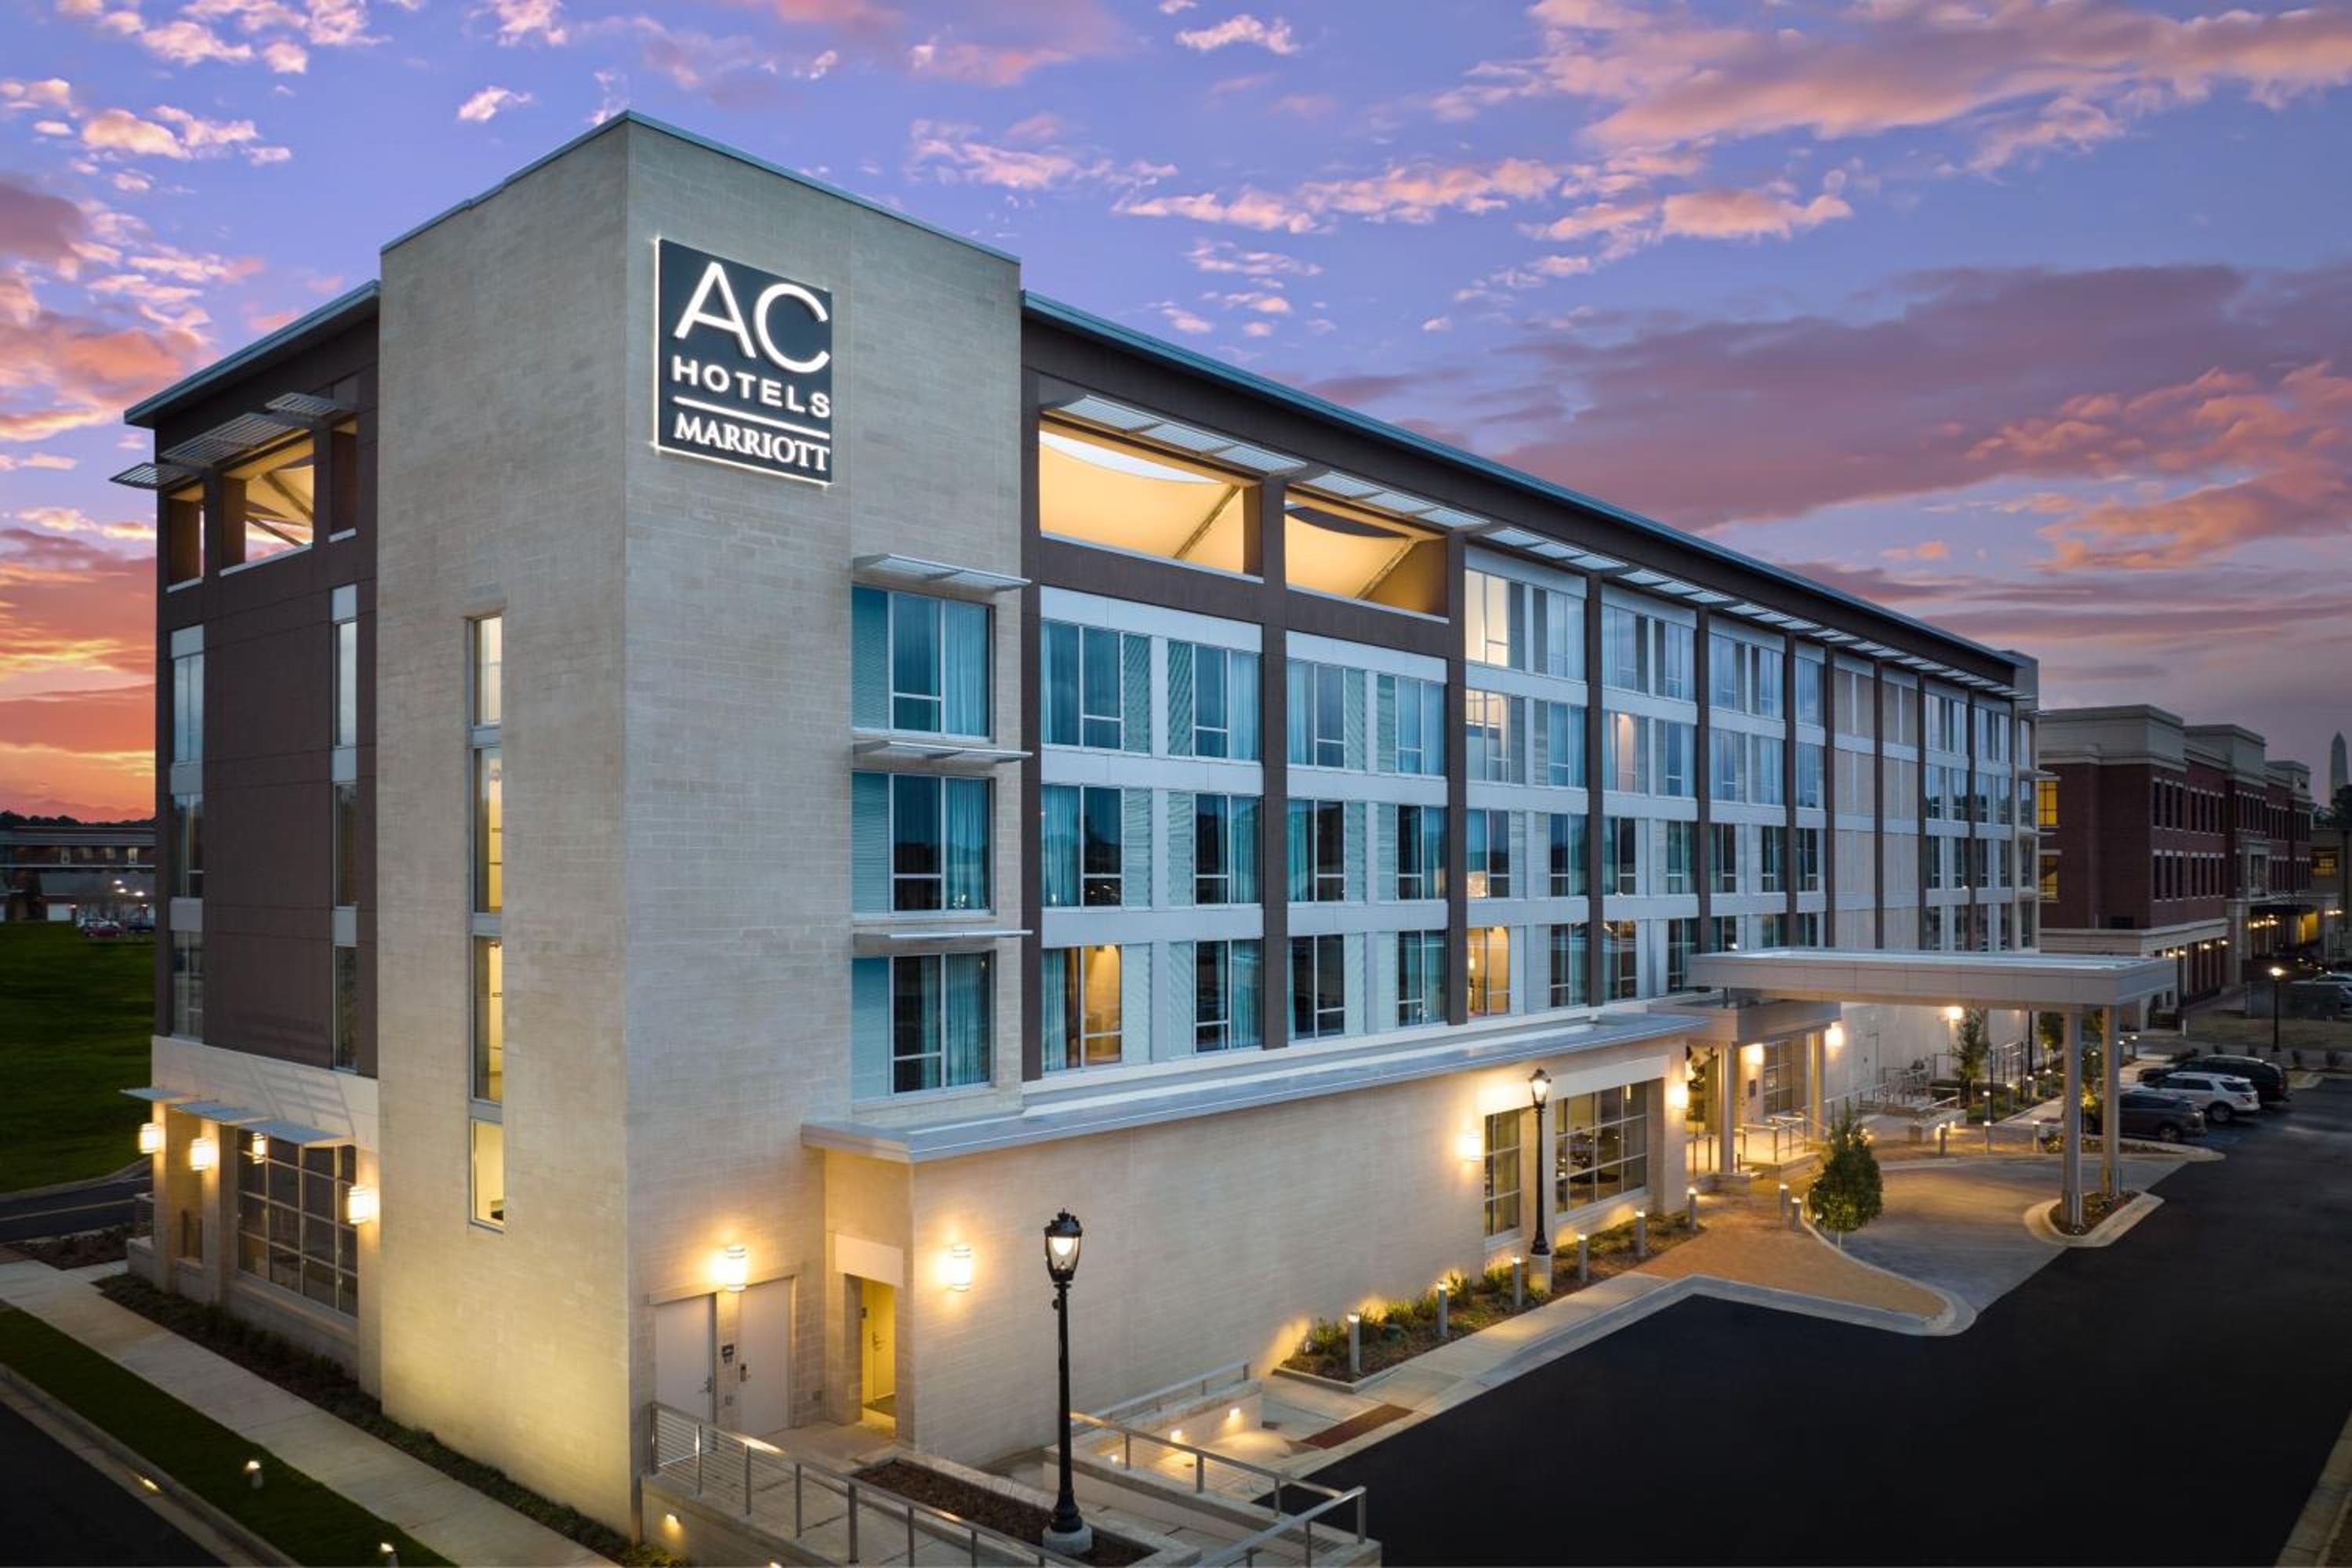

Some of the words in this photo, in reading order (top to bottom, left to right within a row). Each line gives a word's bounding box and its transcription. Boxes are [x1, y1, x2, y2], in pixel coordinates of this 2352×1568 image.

[673, 261, 830, 373] AC
[673, 355, 830, 419] HOTELS
[673, 412, 830, 471] MARRIOTT
